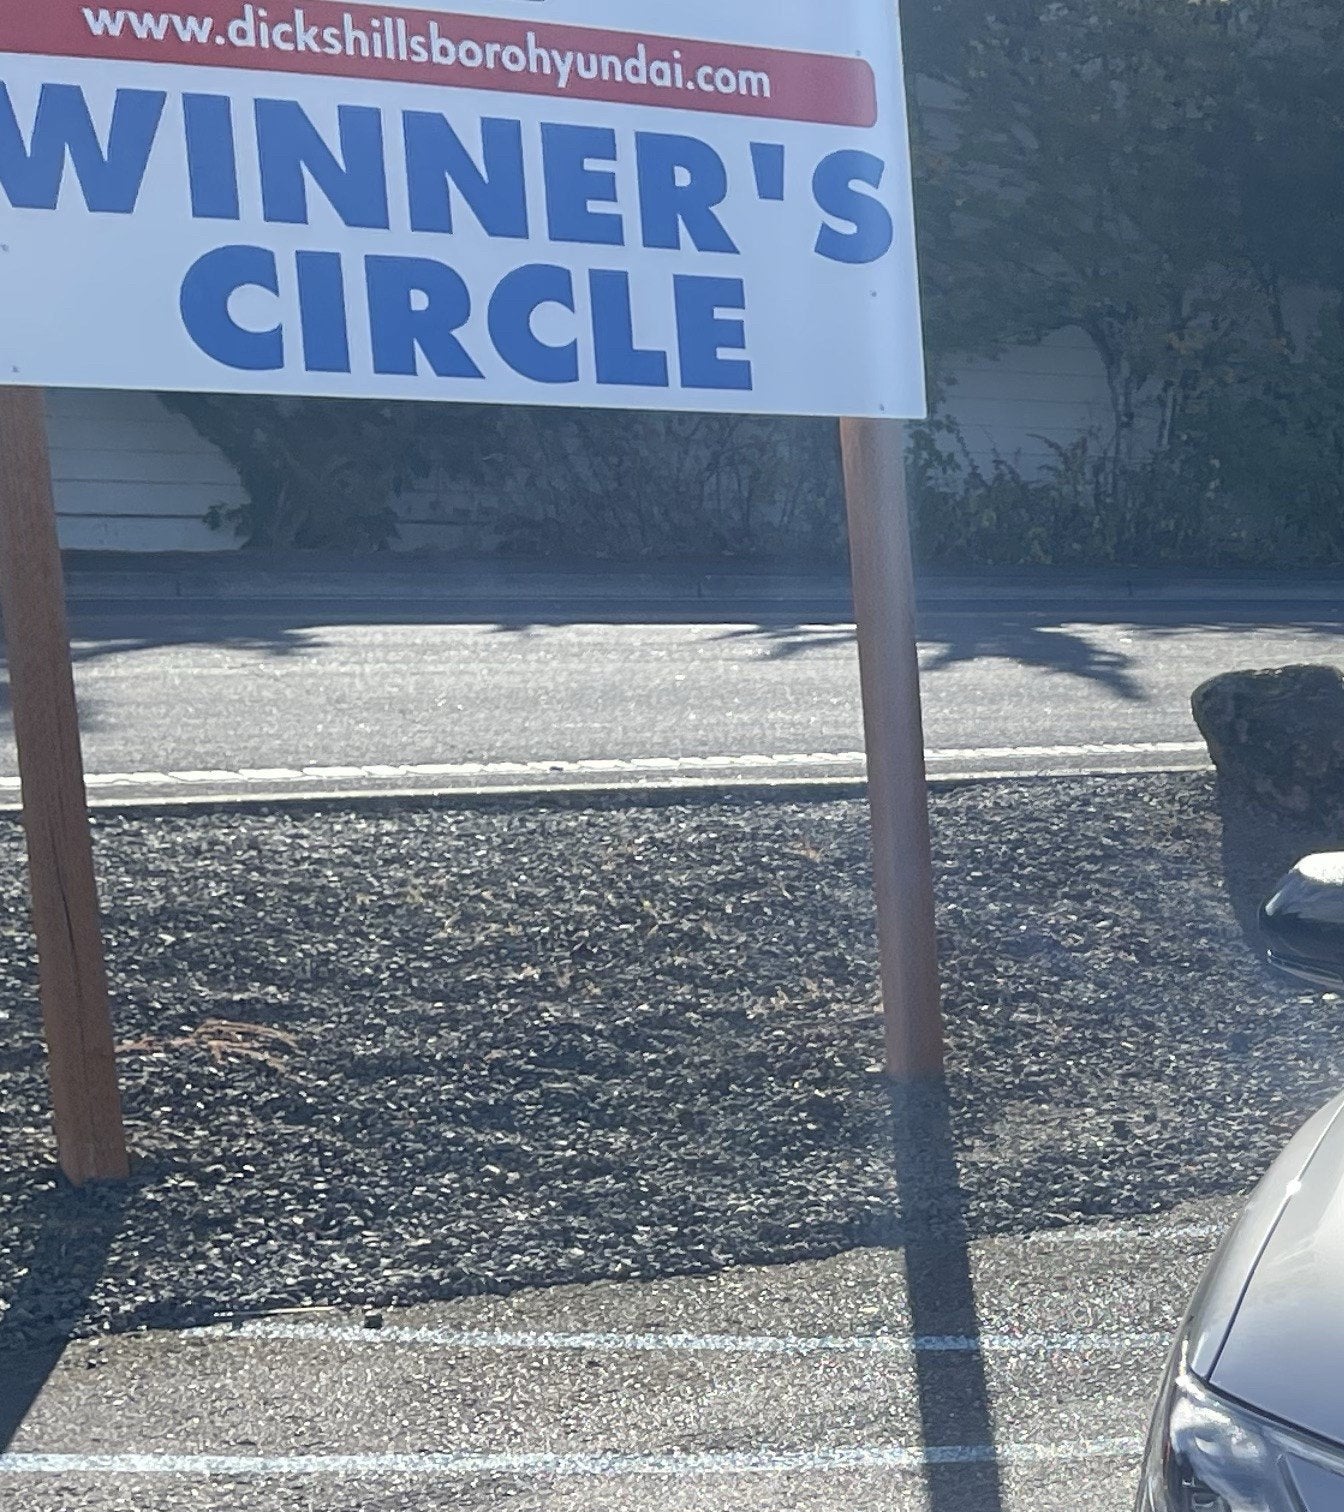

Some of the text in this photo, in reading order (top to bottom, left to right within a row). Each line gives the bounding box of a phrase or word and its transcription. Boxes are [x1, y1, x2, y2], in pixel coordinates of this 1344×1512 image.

[82, 4, 771, 98] www.dickshillsborohyundai.com
[0, 80, 893, 264] WINNER'S
[180, 245, 753, 391] CIRCLE
